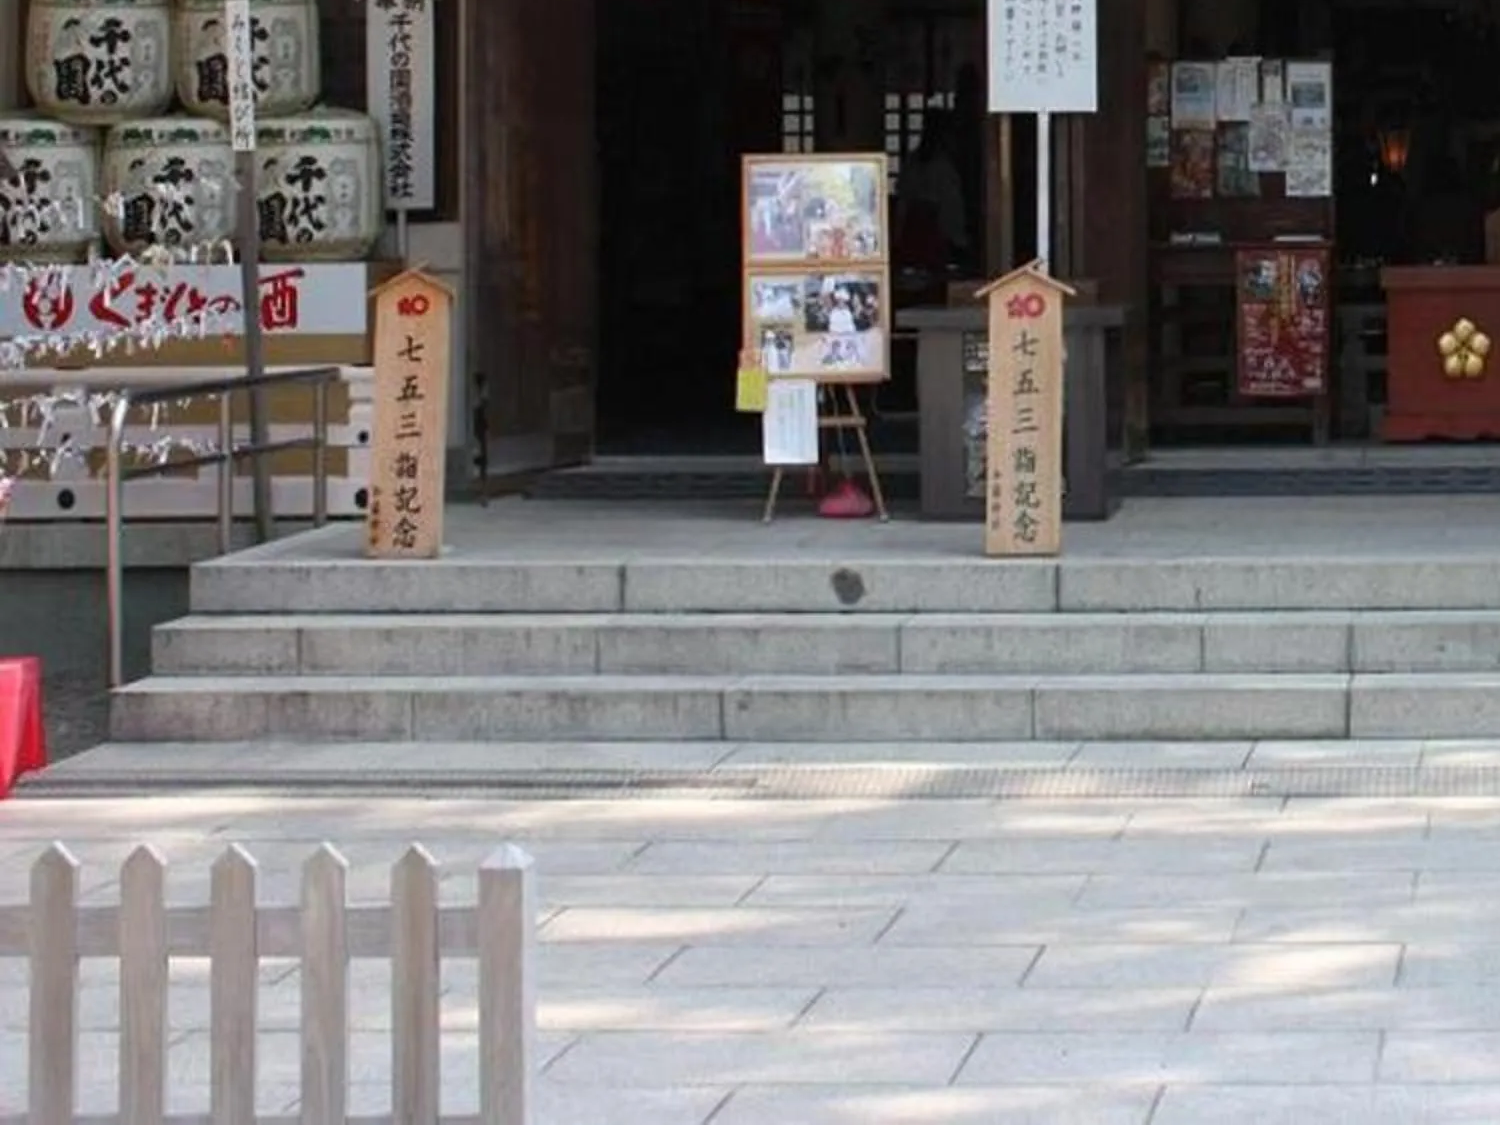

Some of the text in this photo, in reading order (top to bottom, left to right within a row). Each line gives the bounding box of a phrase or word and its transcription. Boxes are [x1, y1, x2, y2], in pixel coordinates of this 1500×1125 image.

[391, 335, 426, 549] 七五三詣記念
[1011, 331, 1040, 543] 七五三詣記念
